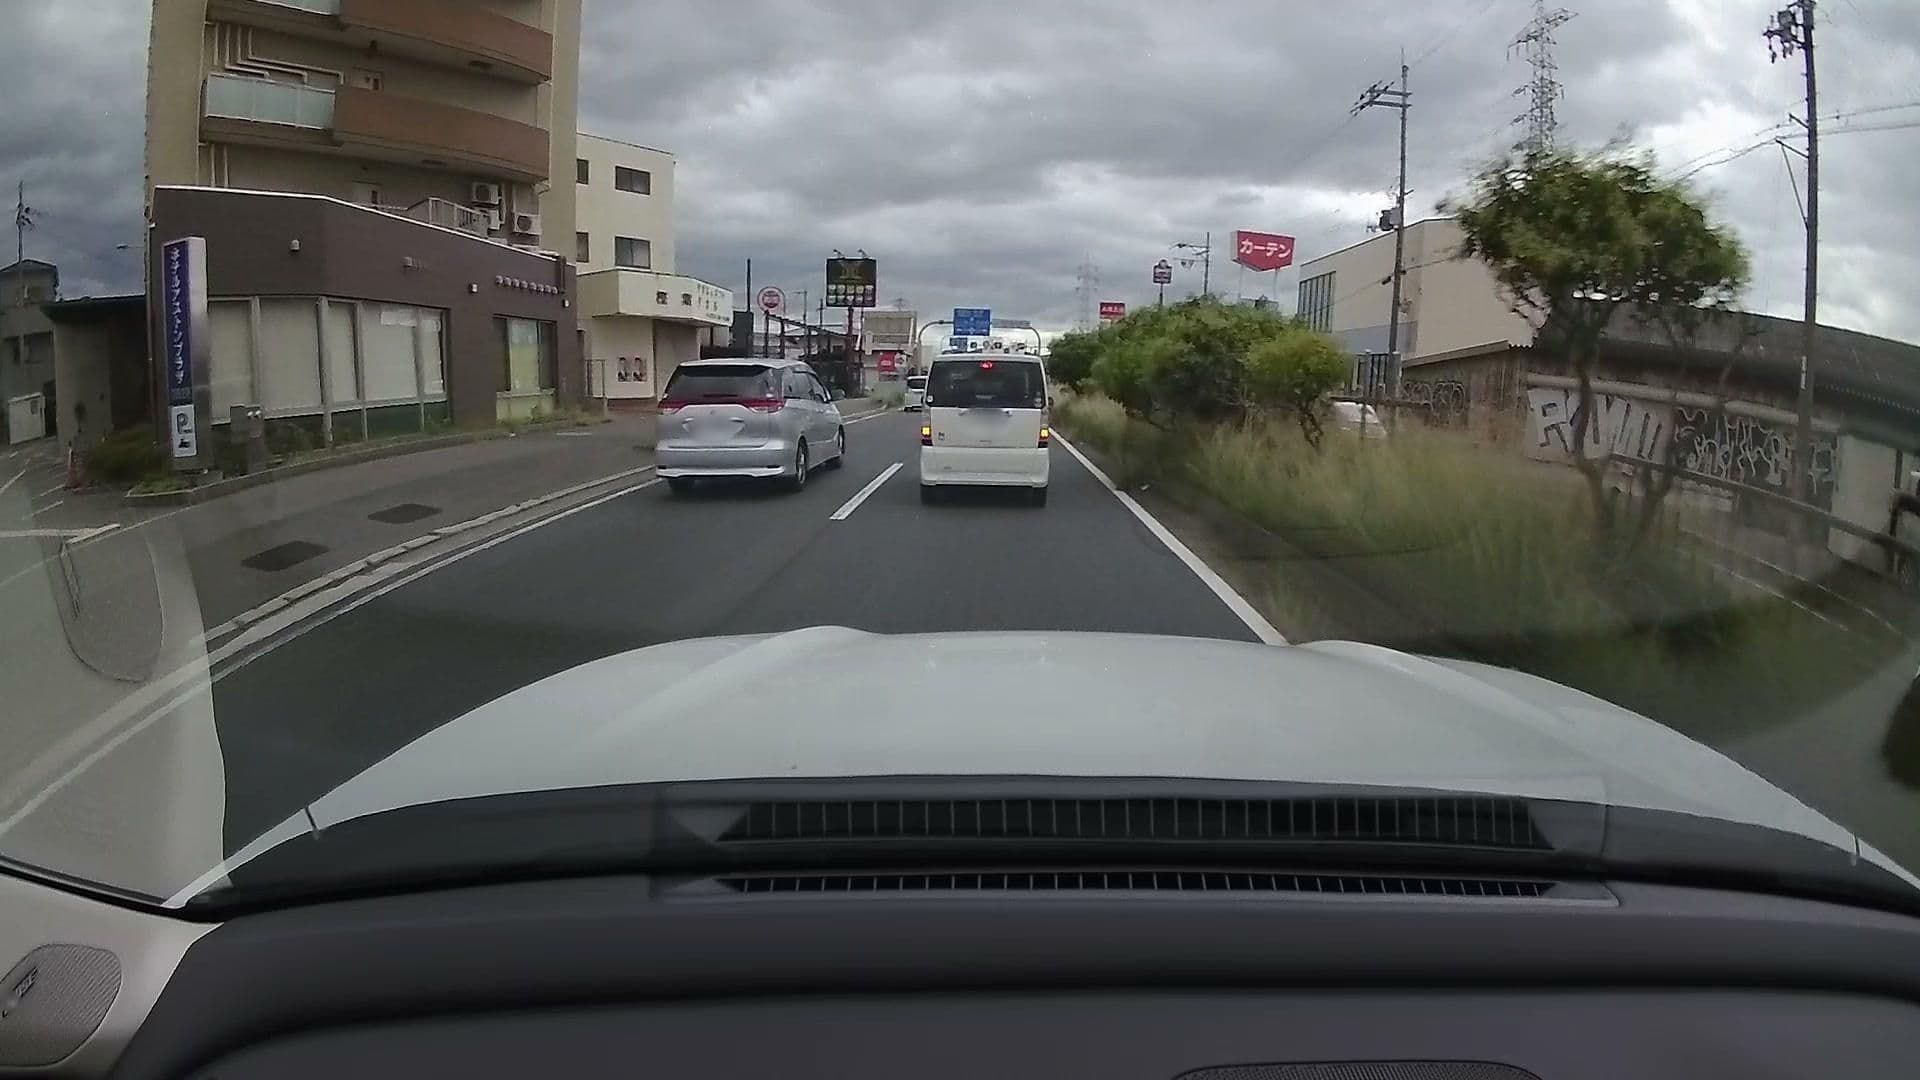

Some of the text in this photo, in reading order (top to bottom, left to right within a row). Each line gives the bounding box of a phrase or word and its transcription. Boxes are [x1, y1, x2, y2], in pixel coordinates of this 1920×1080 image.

[1239, 238, 1291, 257] カーテン
[176, 412, 189, 434] P
